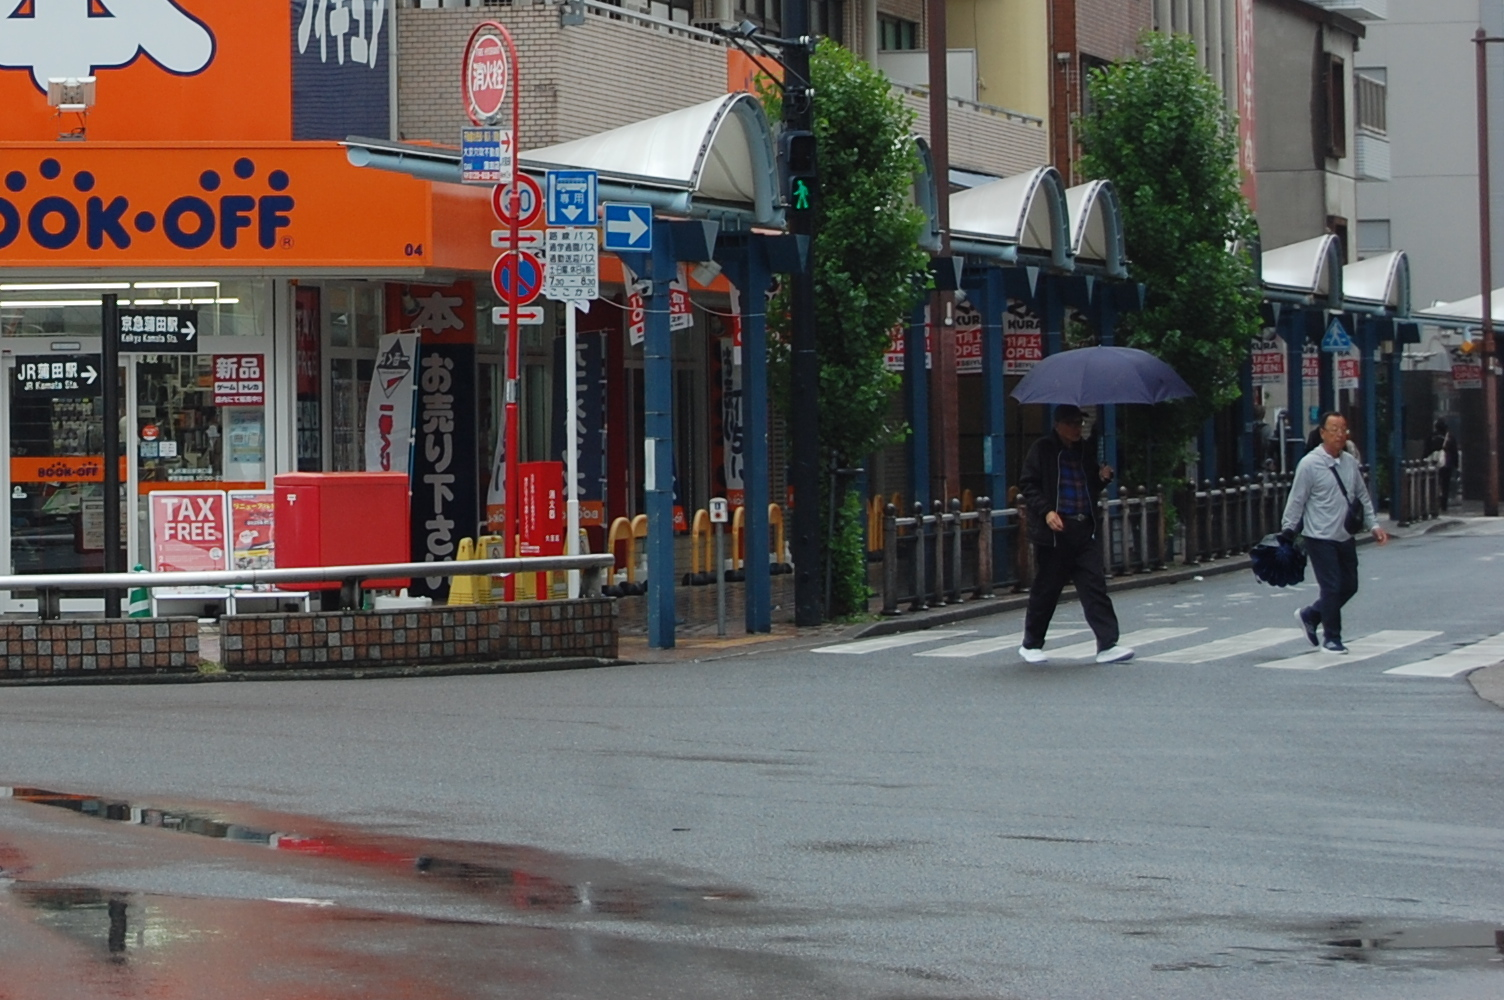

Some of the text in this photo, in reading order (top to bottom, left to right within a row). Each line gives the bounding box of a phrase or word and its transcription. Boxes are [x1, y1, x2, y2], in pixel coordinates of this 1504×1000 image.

[472, 59, 504, 92] 消火栓
[404, 243, 423, 256] 04
[550, 288, 596, 297] ここから
[410, 291, 464, 334] 本
[121, 315, 178, 332] 京急蒲田駅
[17, 361, 78, 381] JR蒲田駅
[216, 357, 260, 379] 新品
[35, 380, 63, 391] Kamata
[217, 383, 259, 391] ゲーム トレカ
[161, 498, 215, 521] TAX
[164, 522, 216, 541] FREE
